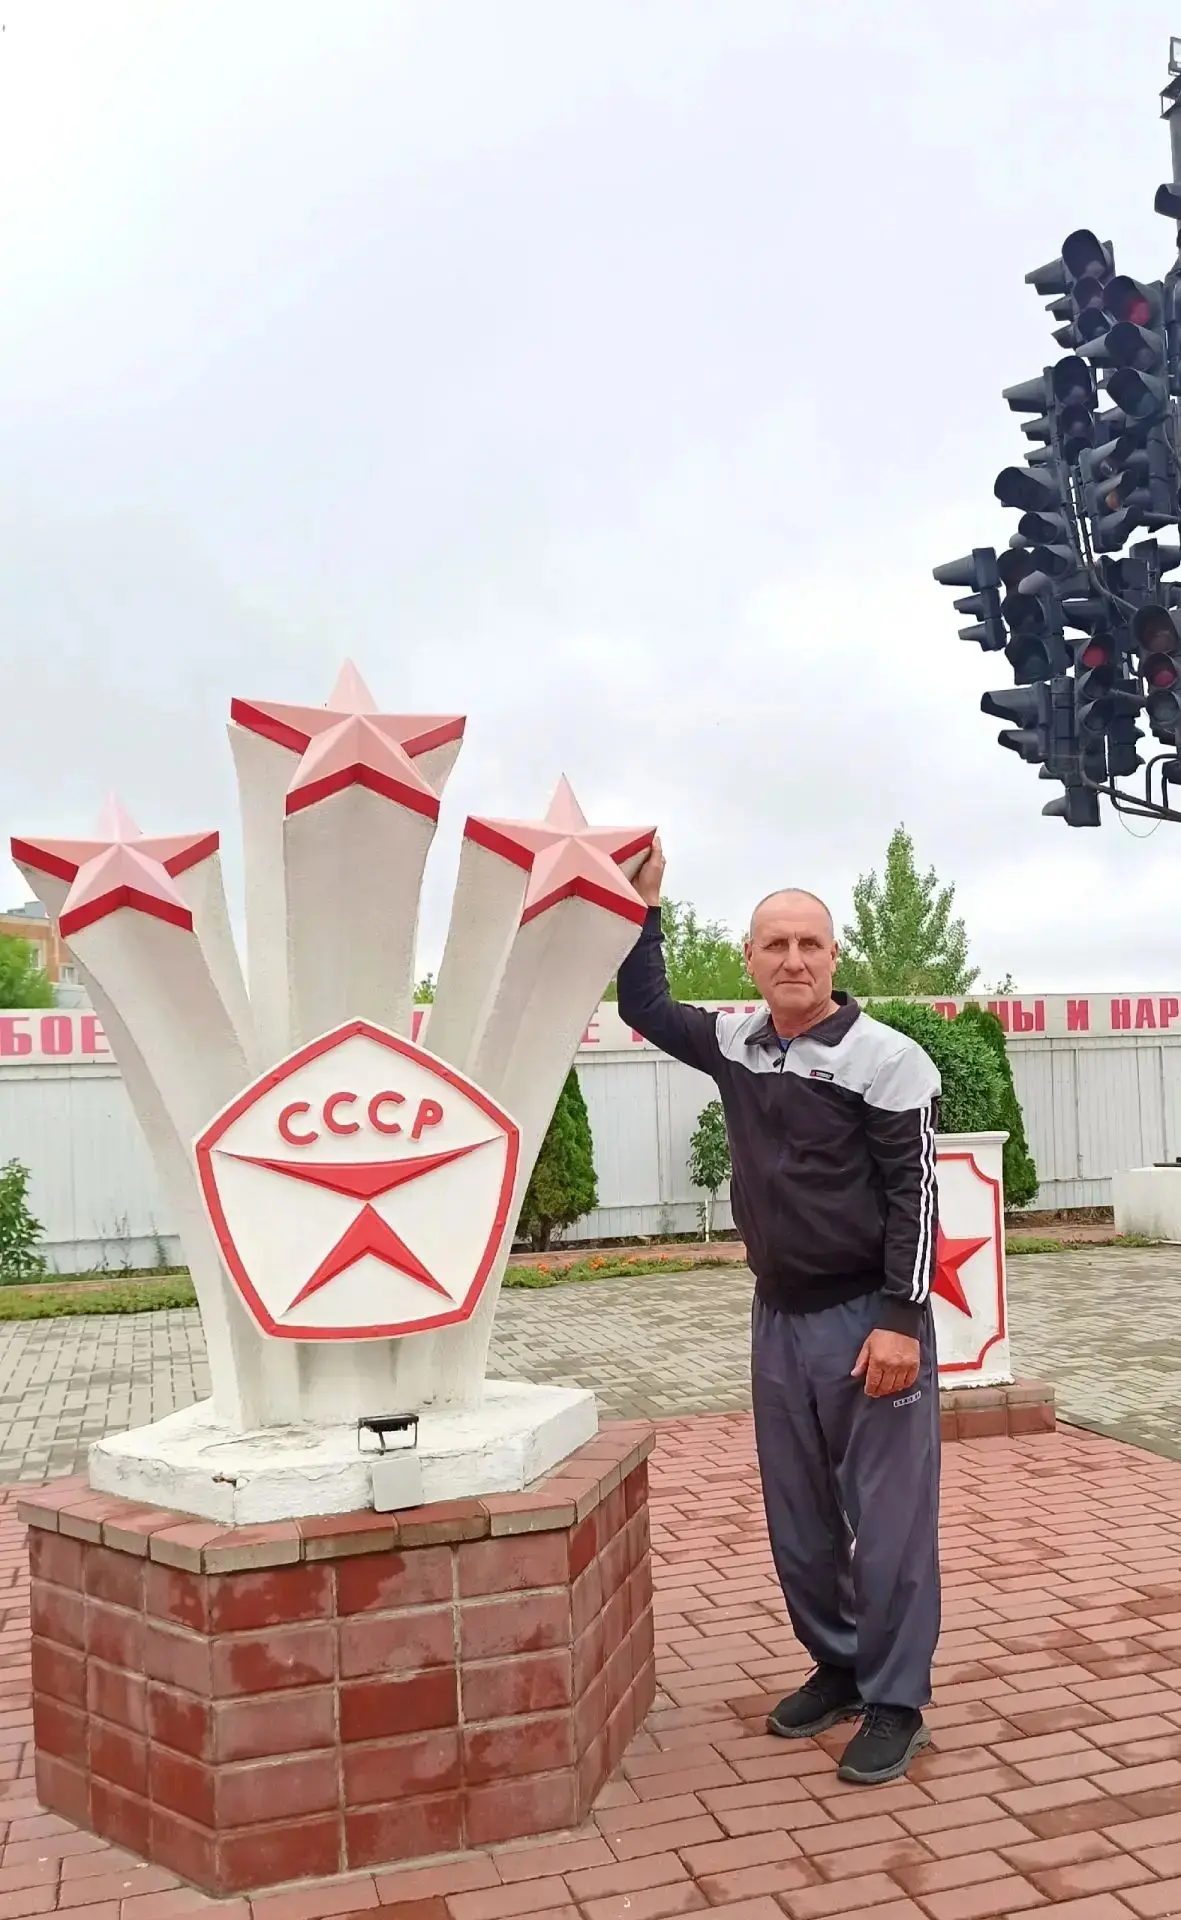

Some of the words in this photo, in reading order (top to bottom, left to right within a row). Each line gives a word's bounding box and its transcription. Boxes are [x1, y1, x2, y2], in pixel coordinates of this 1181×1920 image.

[1066, 1000, 1089, 1031] И
[1111, 998, 1179, 1029] НАР
[278, 1090, 444, 1146] СССР
